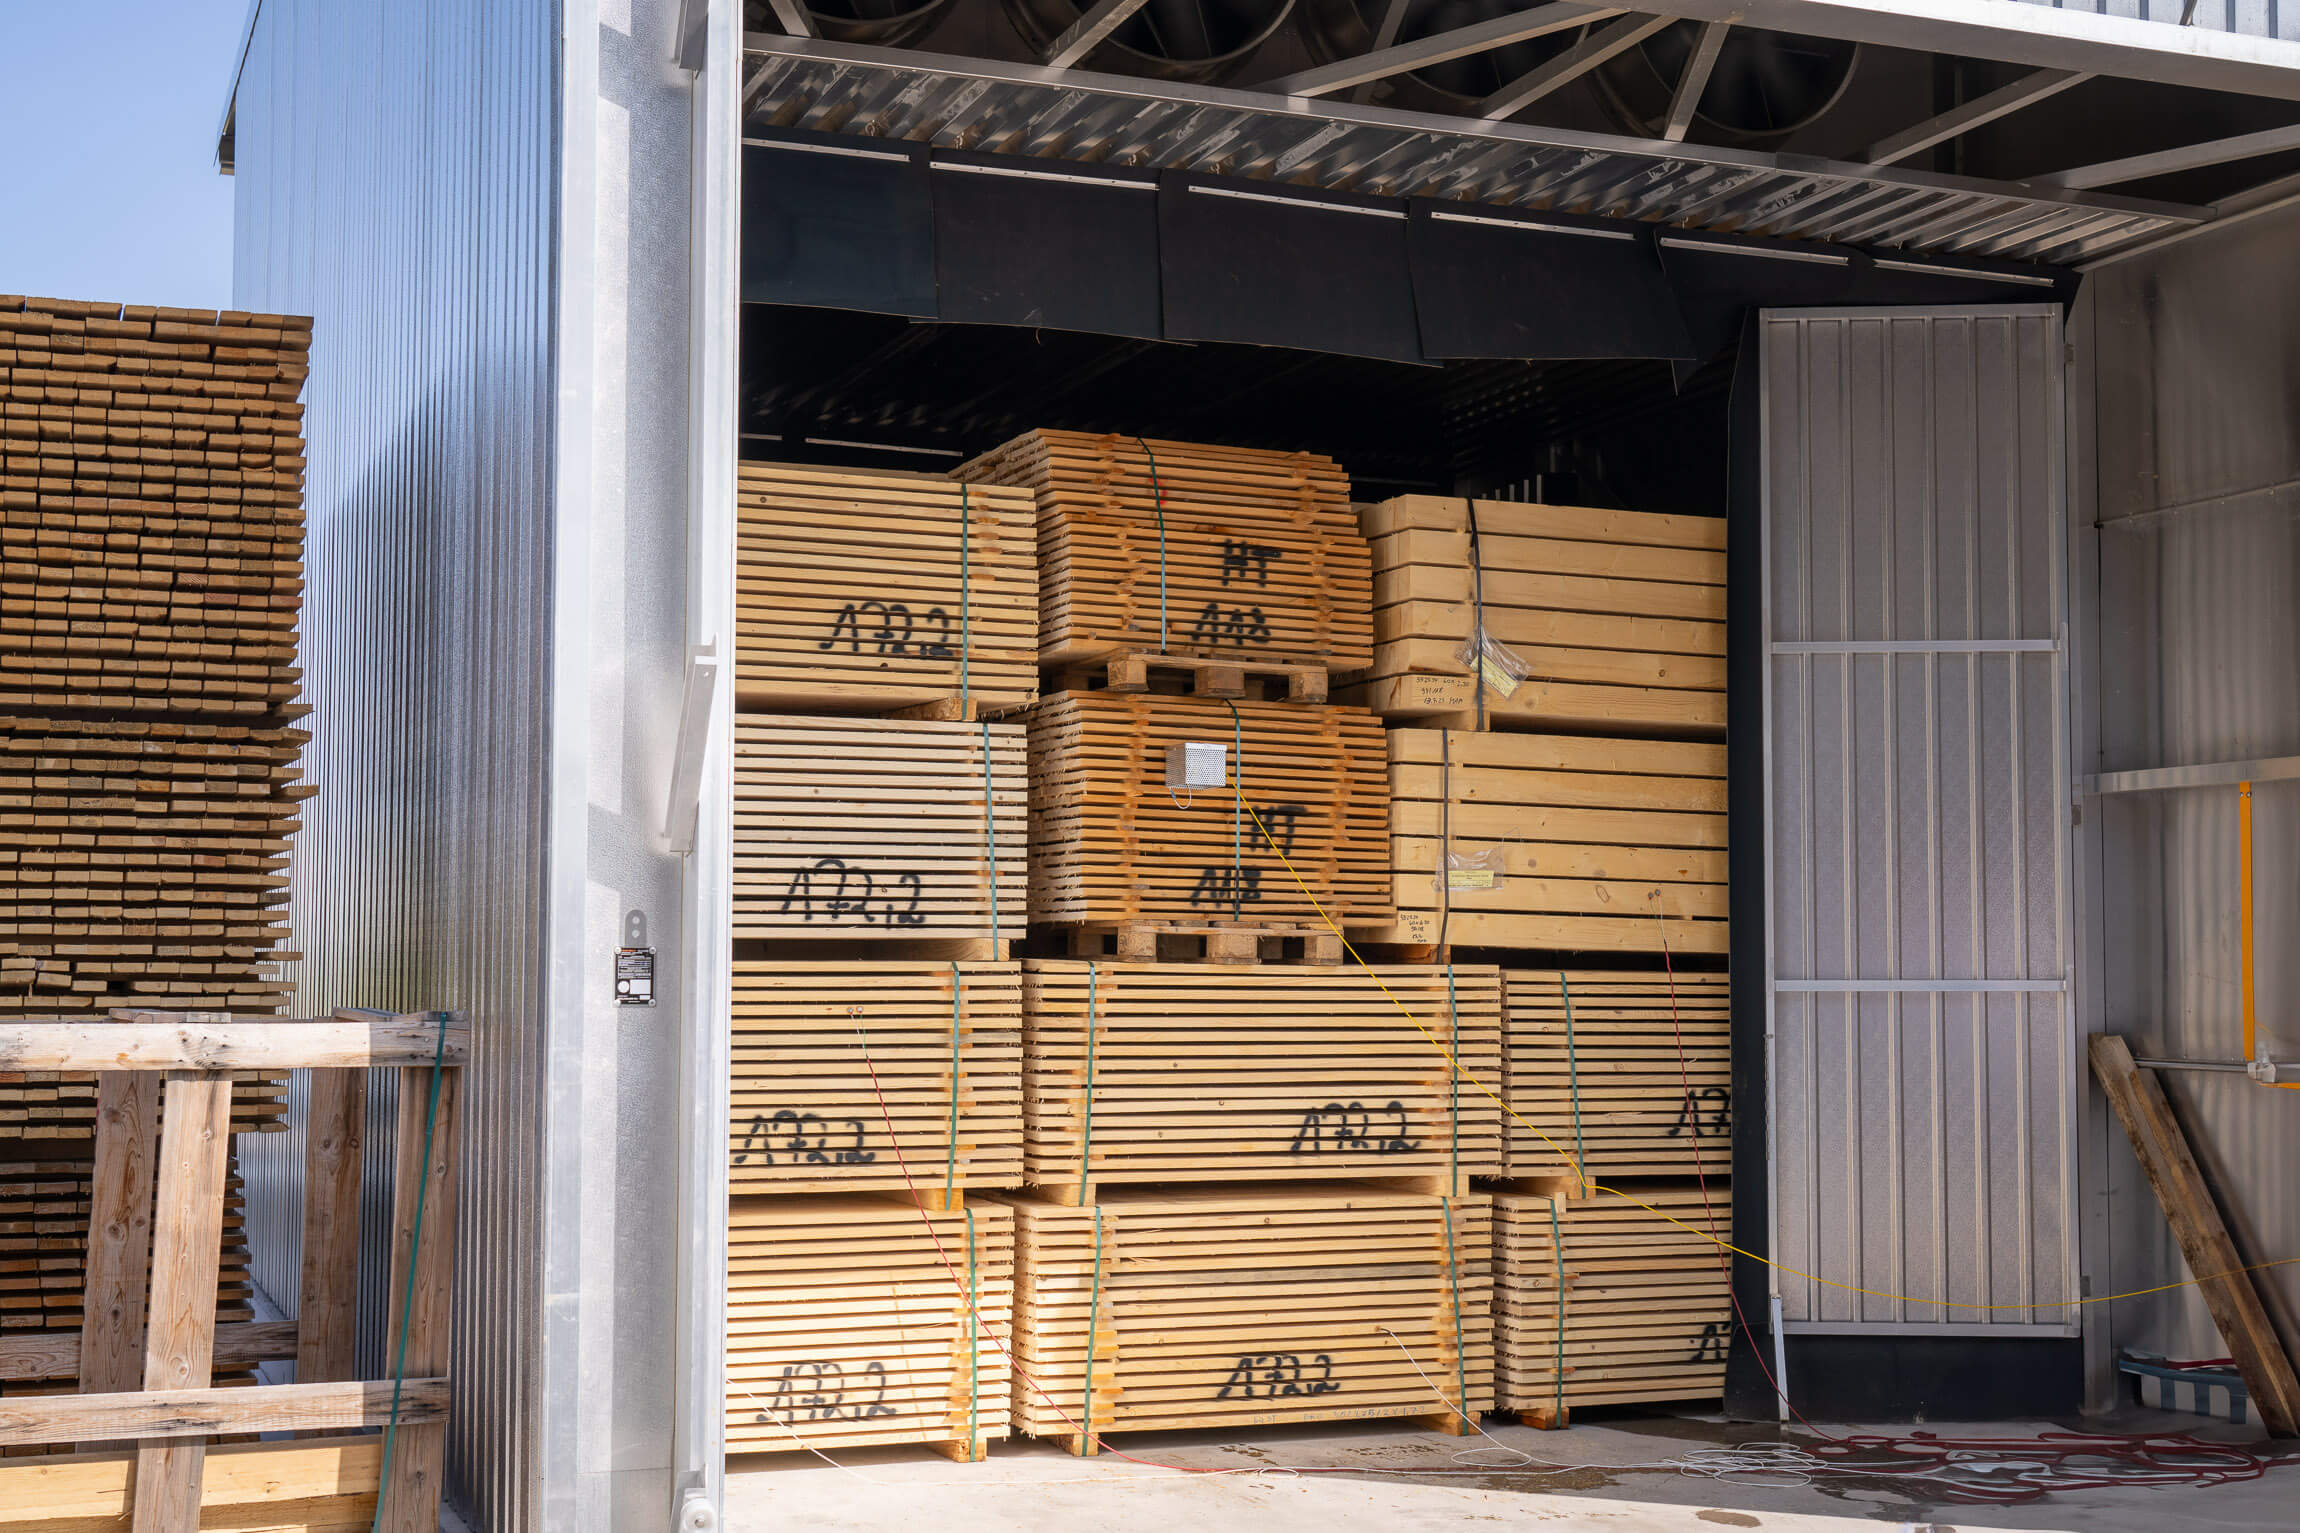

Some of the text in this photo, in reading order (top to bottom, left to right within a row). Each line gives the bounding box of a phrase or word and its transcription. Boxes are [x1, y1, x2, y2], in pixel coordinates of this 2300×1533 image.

[1222, 538, 1282, 588] HT
[1250, 805, 1307, 856] HT
[1667, 1088, 1732, 1137] 17
